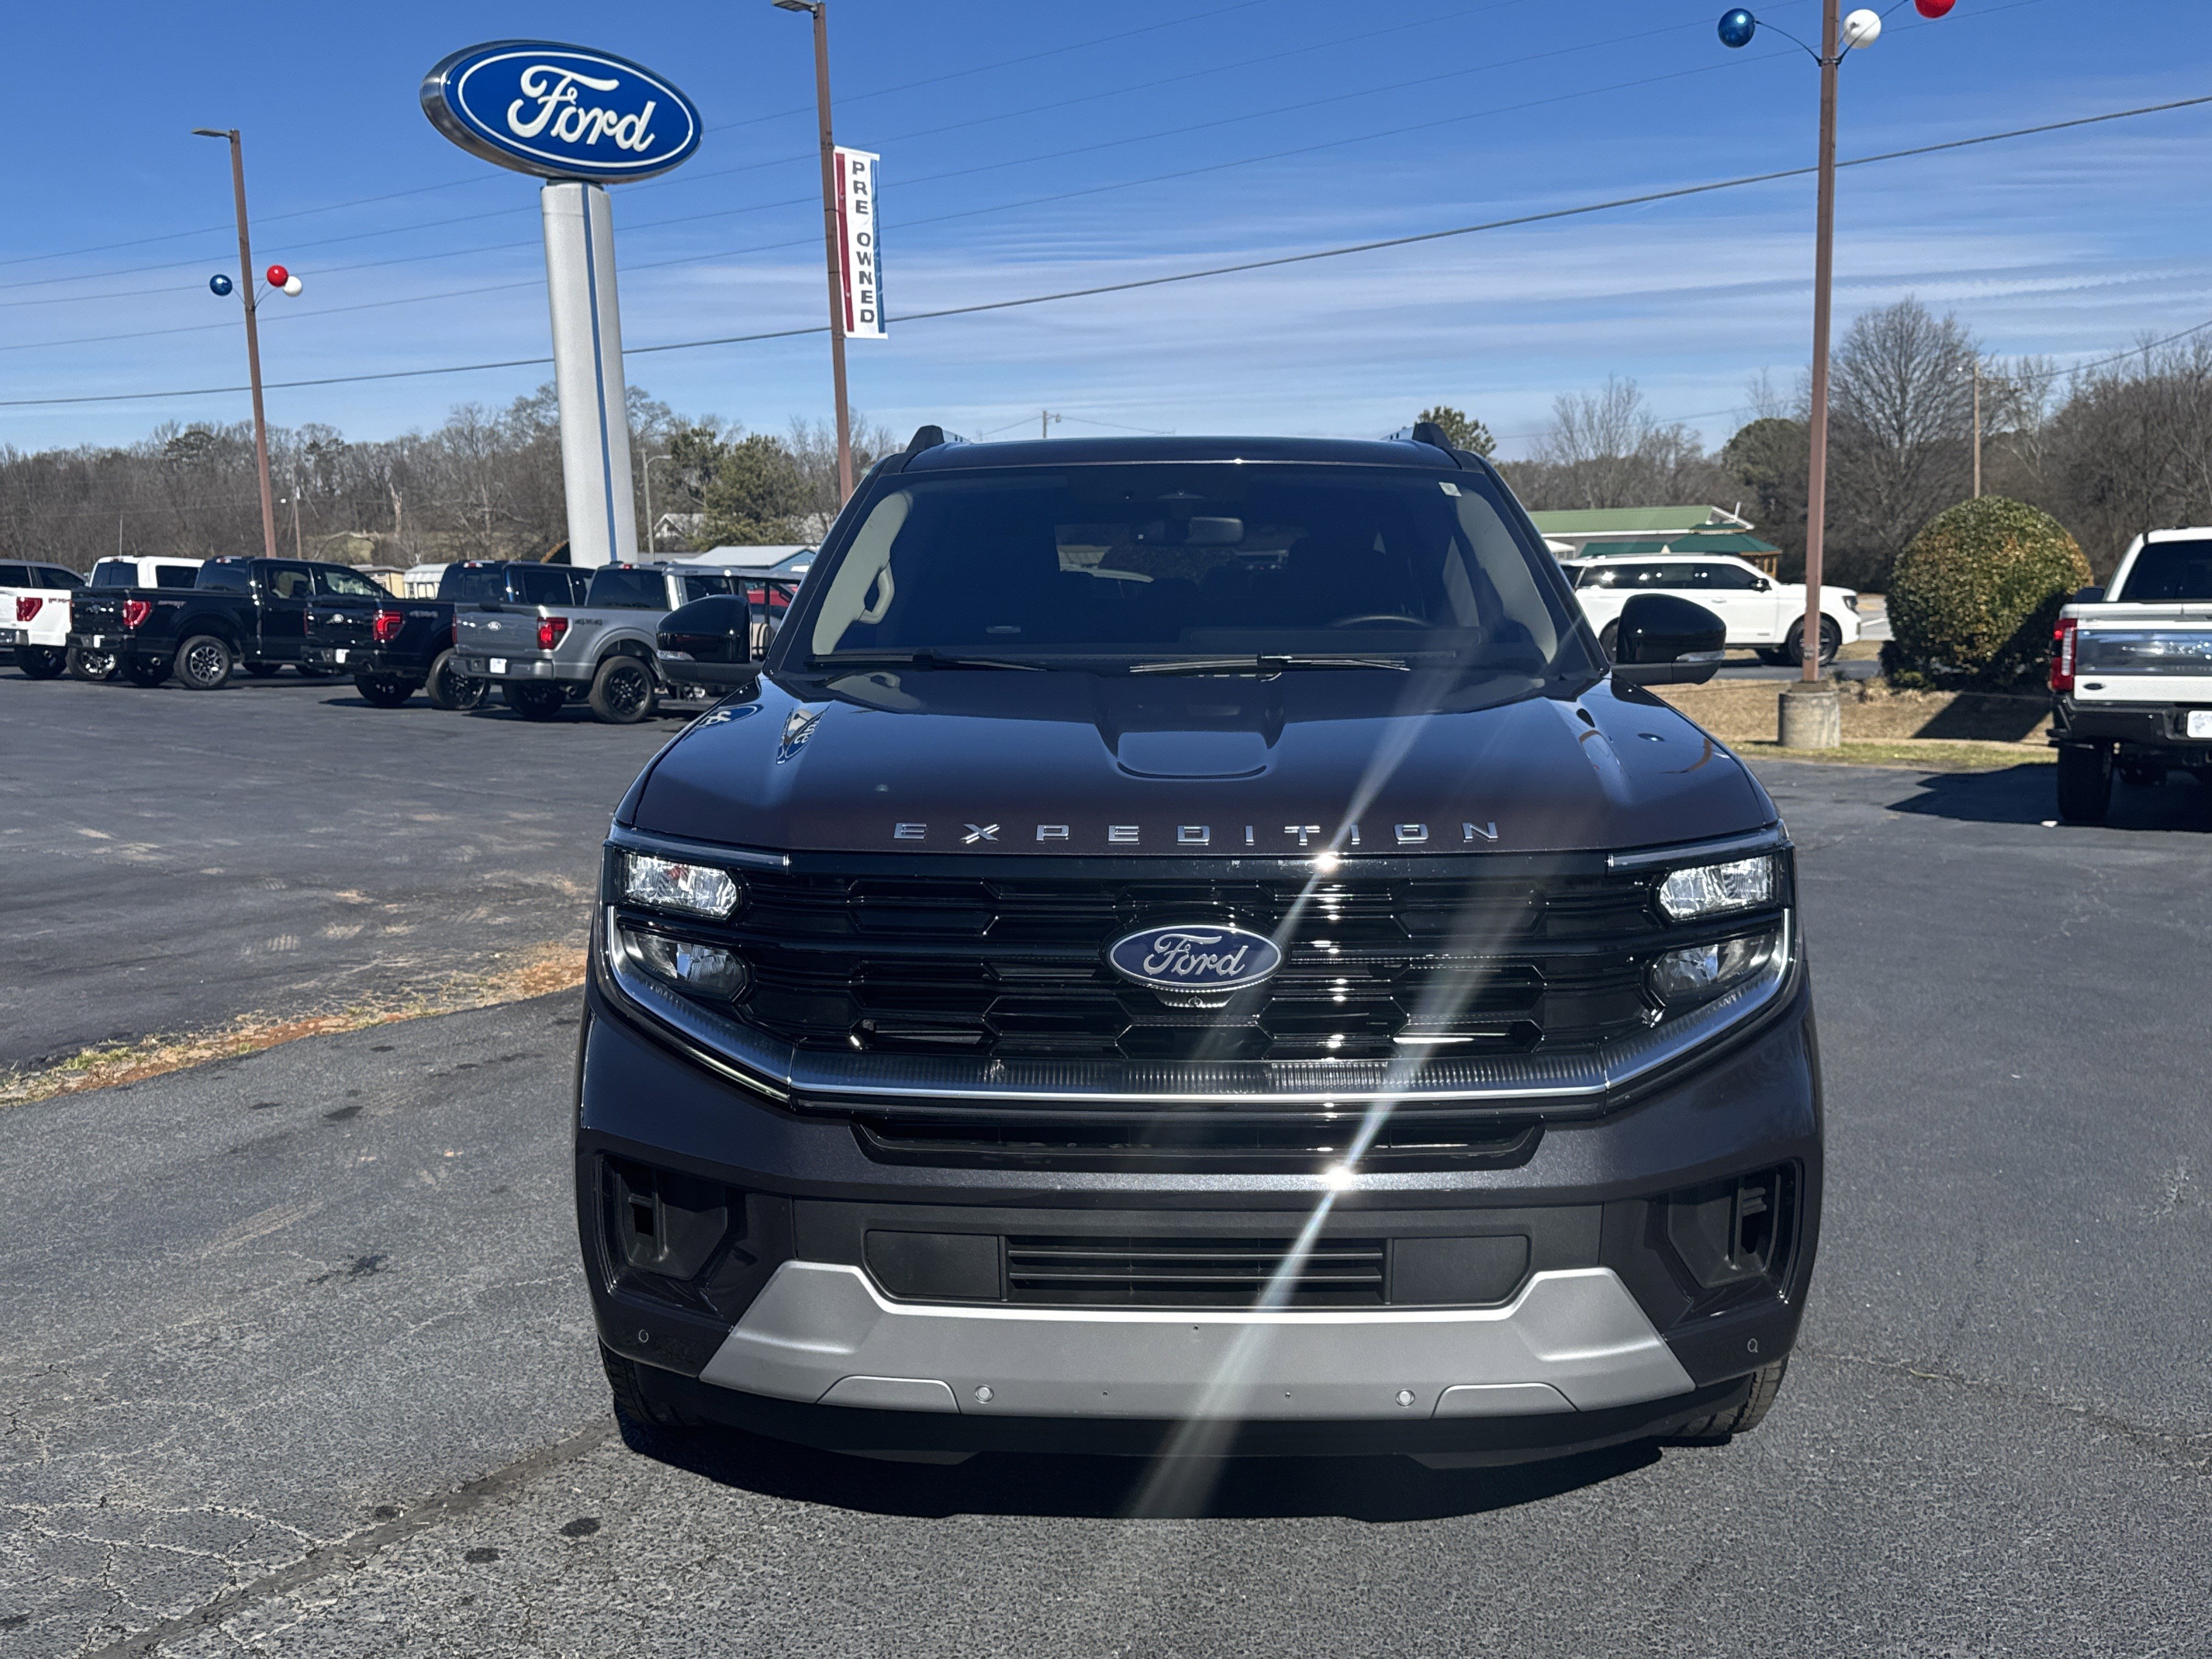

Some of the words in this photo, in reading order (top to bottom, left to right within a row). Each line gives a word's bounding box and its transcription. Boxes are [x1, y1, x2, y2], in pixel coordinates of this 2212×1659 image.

[506, 64, 657, 152] Ford
[852, 160, 869, 215] PRE
[856, 232, 875, 323] OWNED
[893, 822, 1499, 845] EXPEDITION
[1143, 933, 1249, 977] Ford
